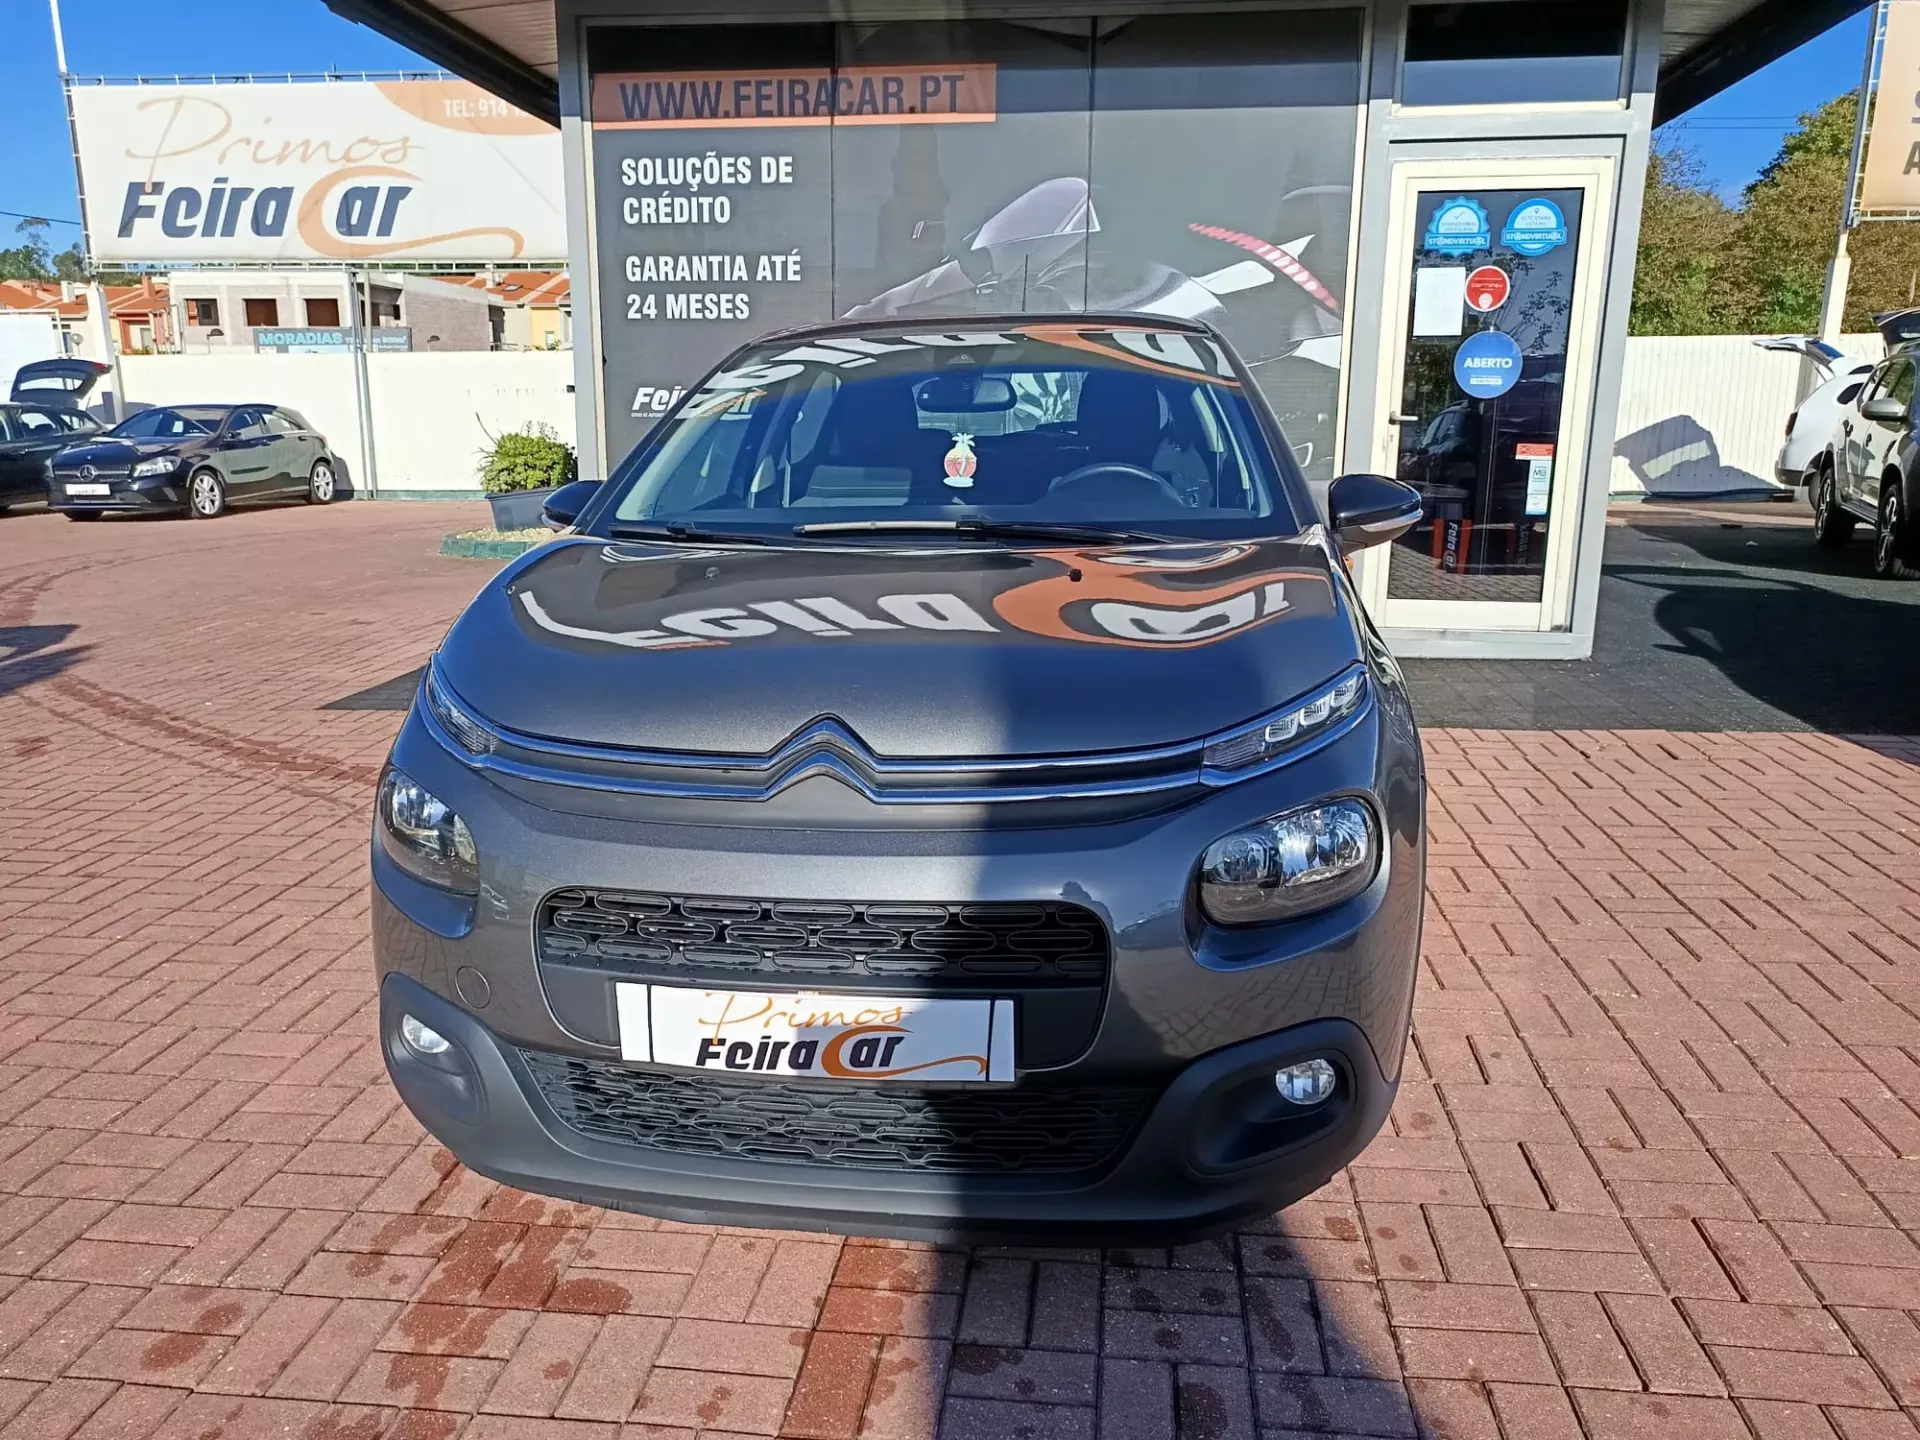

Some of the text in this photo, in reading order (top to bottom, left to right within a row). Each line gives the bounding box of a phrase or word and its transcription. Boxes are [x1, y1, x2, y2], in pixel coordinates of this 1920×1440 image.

[478, 98, 508, 118] 914
[618, 74, 965, 119] WWW.FEIRACAR.PT
[125, 95, 425, 193] Primos
[621, 151, 794, 191] SOLUÇÕES DE
[623, 191, 731, 224] CRÉDITO
[625, 249, 802, 282] GARANTIA ATÉ
[626, 293, 750, 320] 24 MESES
[258, 332, 343, 345] MORADIAS
[1463, 356, 1513, 369] ABERTO
[698, 991, 914, 1044] Primos
